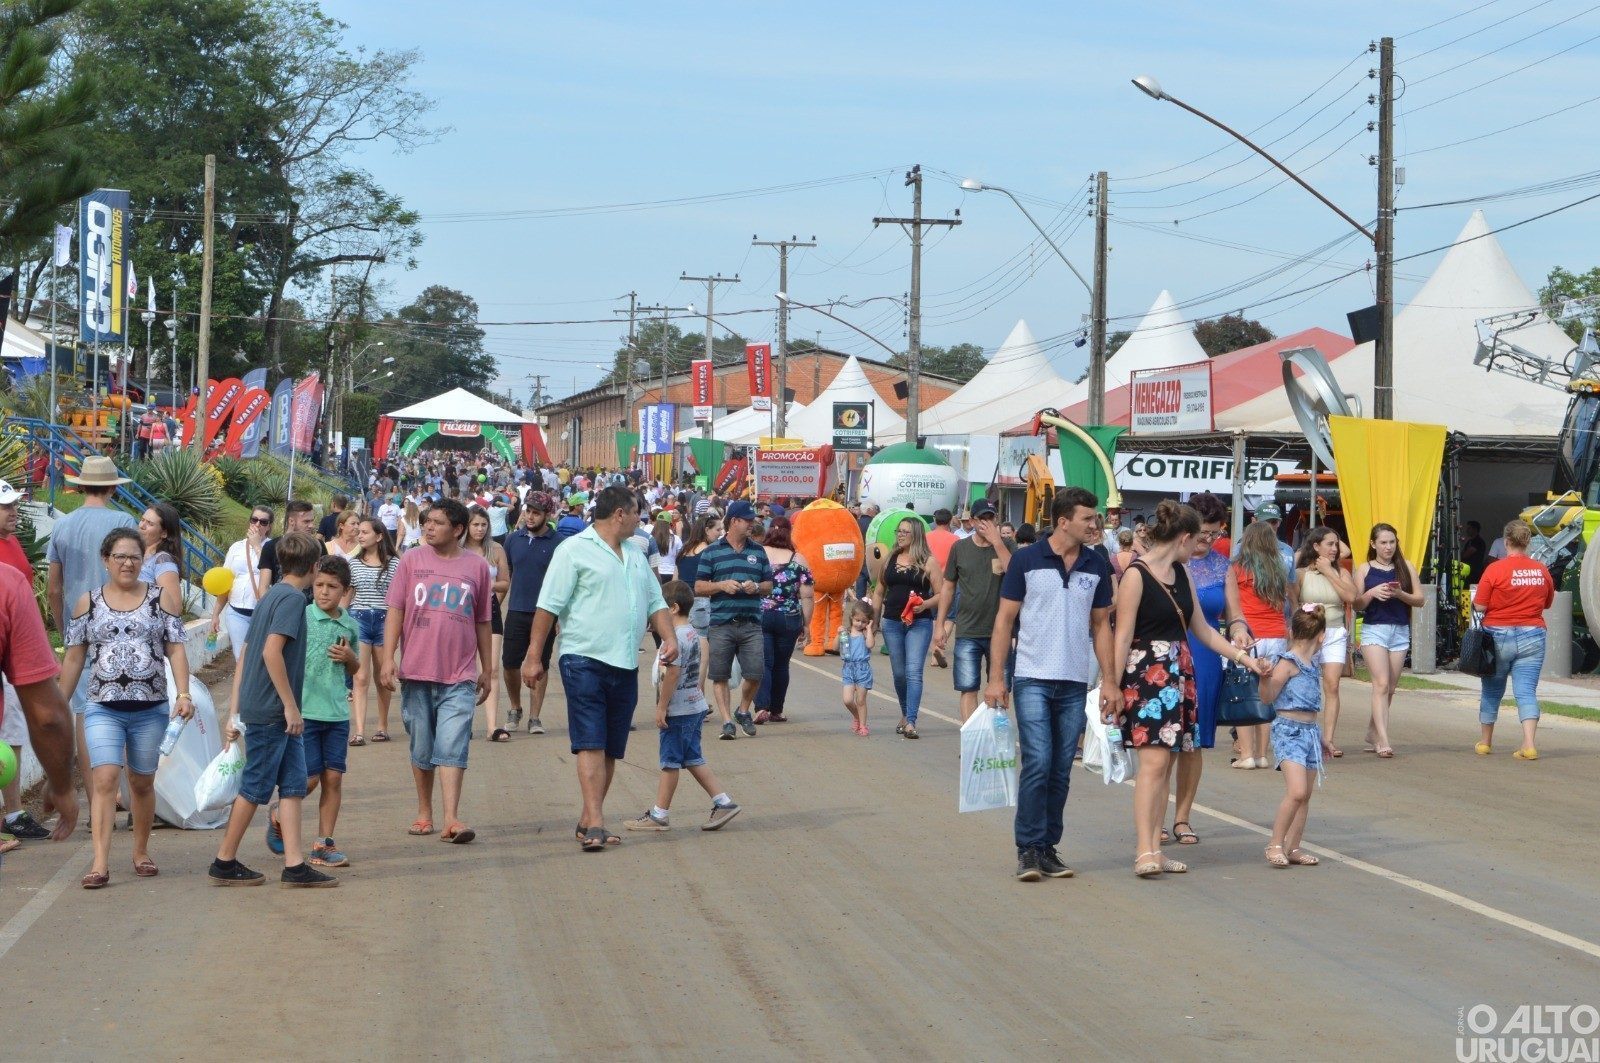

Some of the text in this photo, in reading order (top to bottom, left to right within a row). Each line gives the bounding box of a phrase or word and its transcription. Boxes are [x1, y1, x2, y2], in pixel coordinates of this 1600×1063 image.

[86, 200, 112, 334] CHICO
[699, 364, 708, 403] VALTRA
[754, 348, 765, 393] VALTRA
[210, 384, 239, 420] VALTRA
[236, 394, 264, 425] VALTRA
[762, 451, 815, 462] PROMOÇÃO
[900, 481, 945, 489] COTRIFRED
[1511, 577, 1545, 586] COMIGO!
[1512, 569, 1543, 577] ASSINE
